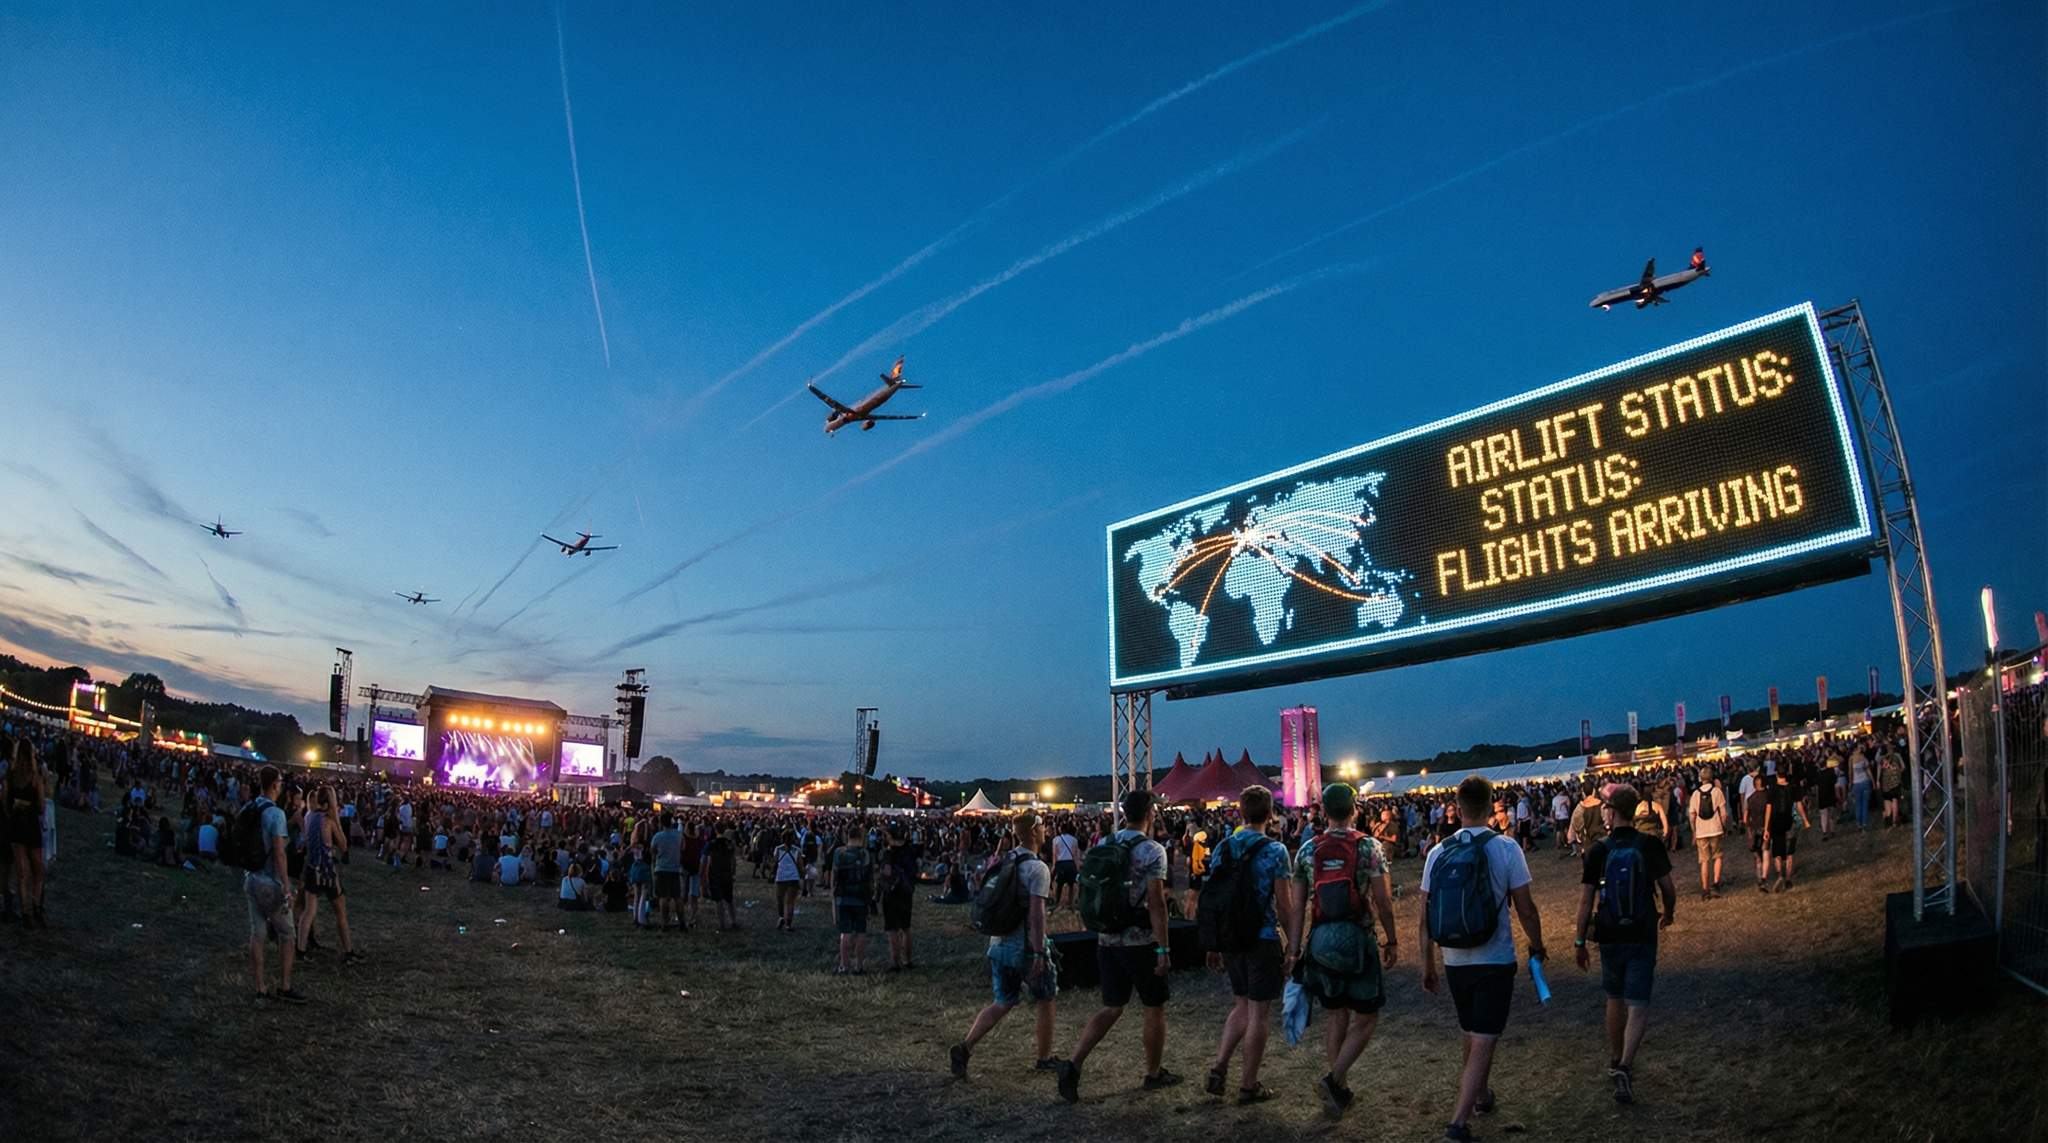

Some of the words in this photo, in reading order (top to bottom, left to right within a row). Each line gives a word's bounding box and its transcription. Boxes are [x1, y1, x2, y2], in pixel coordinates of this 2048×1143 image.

[1448, 403, 1602, 487] AIRLIFT
[1620, 350, 1793, 437] STATUS:
[1437, 519, 1597, 596] FLIGHTS
[1609, 464, 1803, 556] ARRIVING
[1481, 453, 1642, 530] STATUS:
